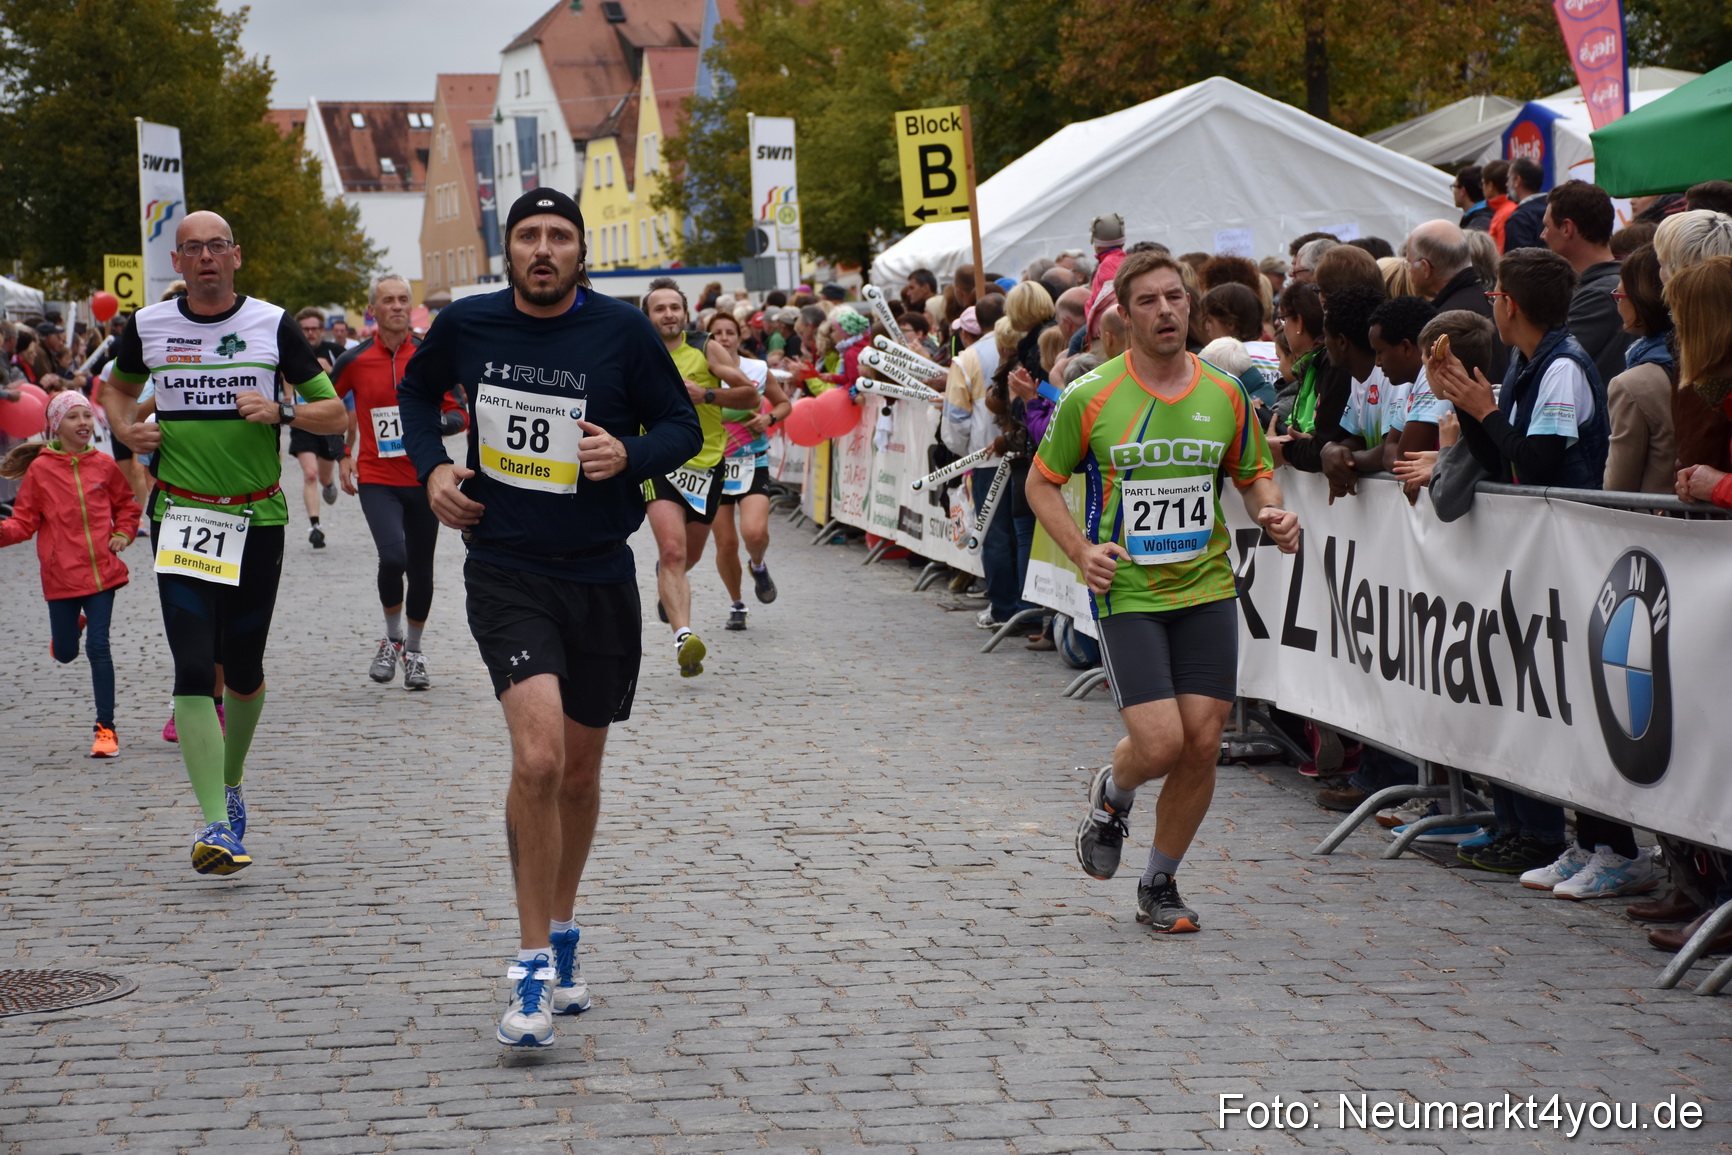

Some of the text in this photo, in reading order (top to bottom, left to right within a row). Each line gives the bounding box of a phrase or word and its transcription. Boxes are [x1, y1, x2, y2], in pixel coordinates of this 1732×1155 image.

[905, 112, 962, 136] Block
[142, 153, 180, 173] swn
[757, 145, 793, 160] swn
[918, 143, 957, 199] B
[109, 258, 138, 268] Block
[114, 273, 133, 298] C
[166, 355, 202, 363] OBI
[164, 375, 257, 389] Laufteam
[512, 365, 586, 390] RUN
[883, 363, 907, 382] BMW
[184, 391, 237, 405] Fürth
[480, 394, 566, 417] PARTL Neumarkt
[506, 414, 550, 453] 58
[1110, 438, 1226, 470] BOCK
[500, 457, 550, 478] Charles
[1125, 485, 1200, 496] PARTL Neumarkt
[164, 512, 233, 529] PARTL Neumarkt
[975, 504, 991, 532] BMW
[1133, 496, 1207, 531] 2714
[179, 526, 226, 558] 121
[1143, 538, 1198, 552] Wolfgang
[173, 554, 222, 574] Bernhard
[1597, 555, 1668, 635] BMW
[1324, 535, 1573, 726] Neumarkt
